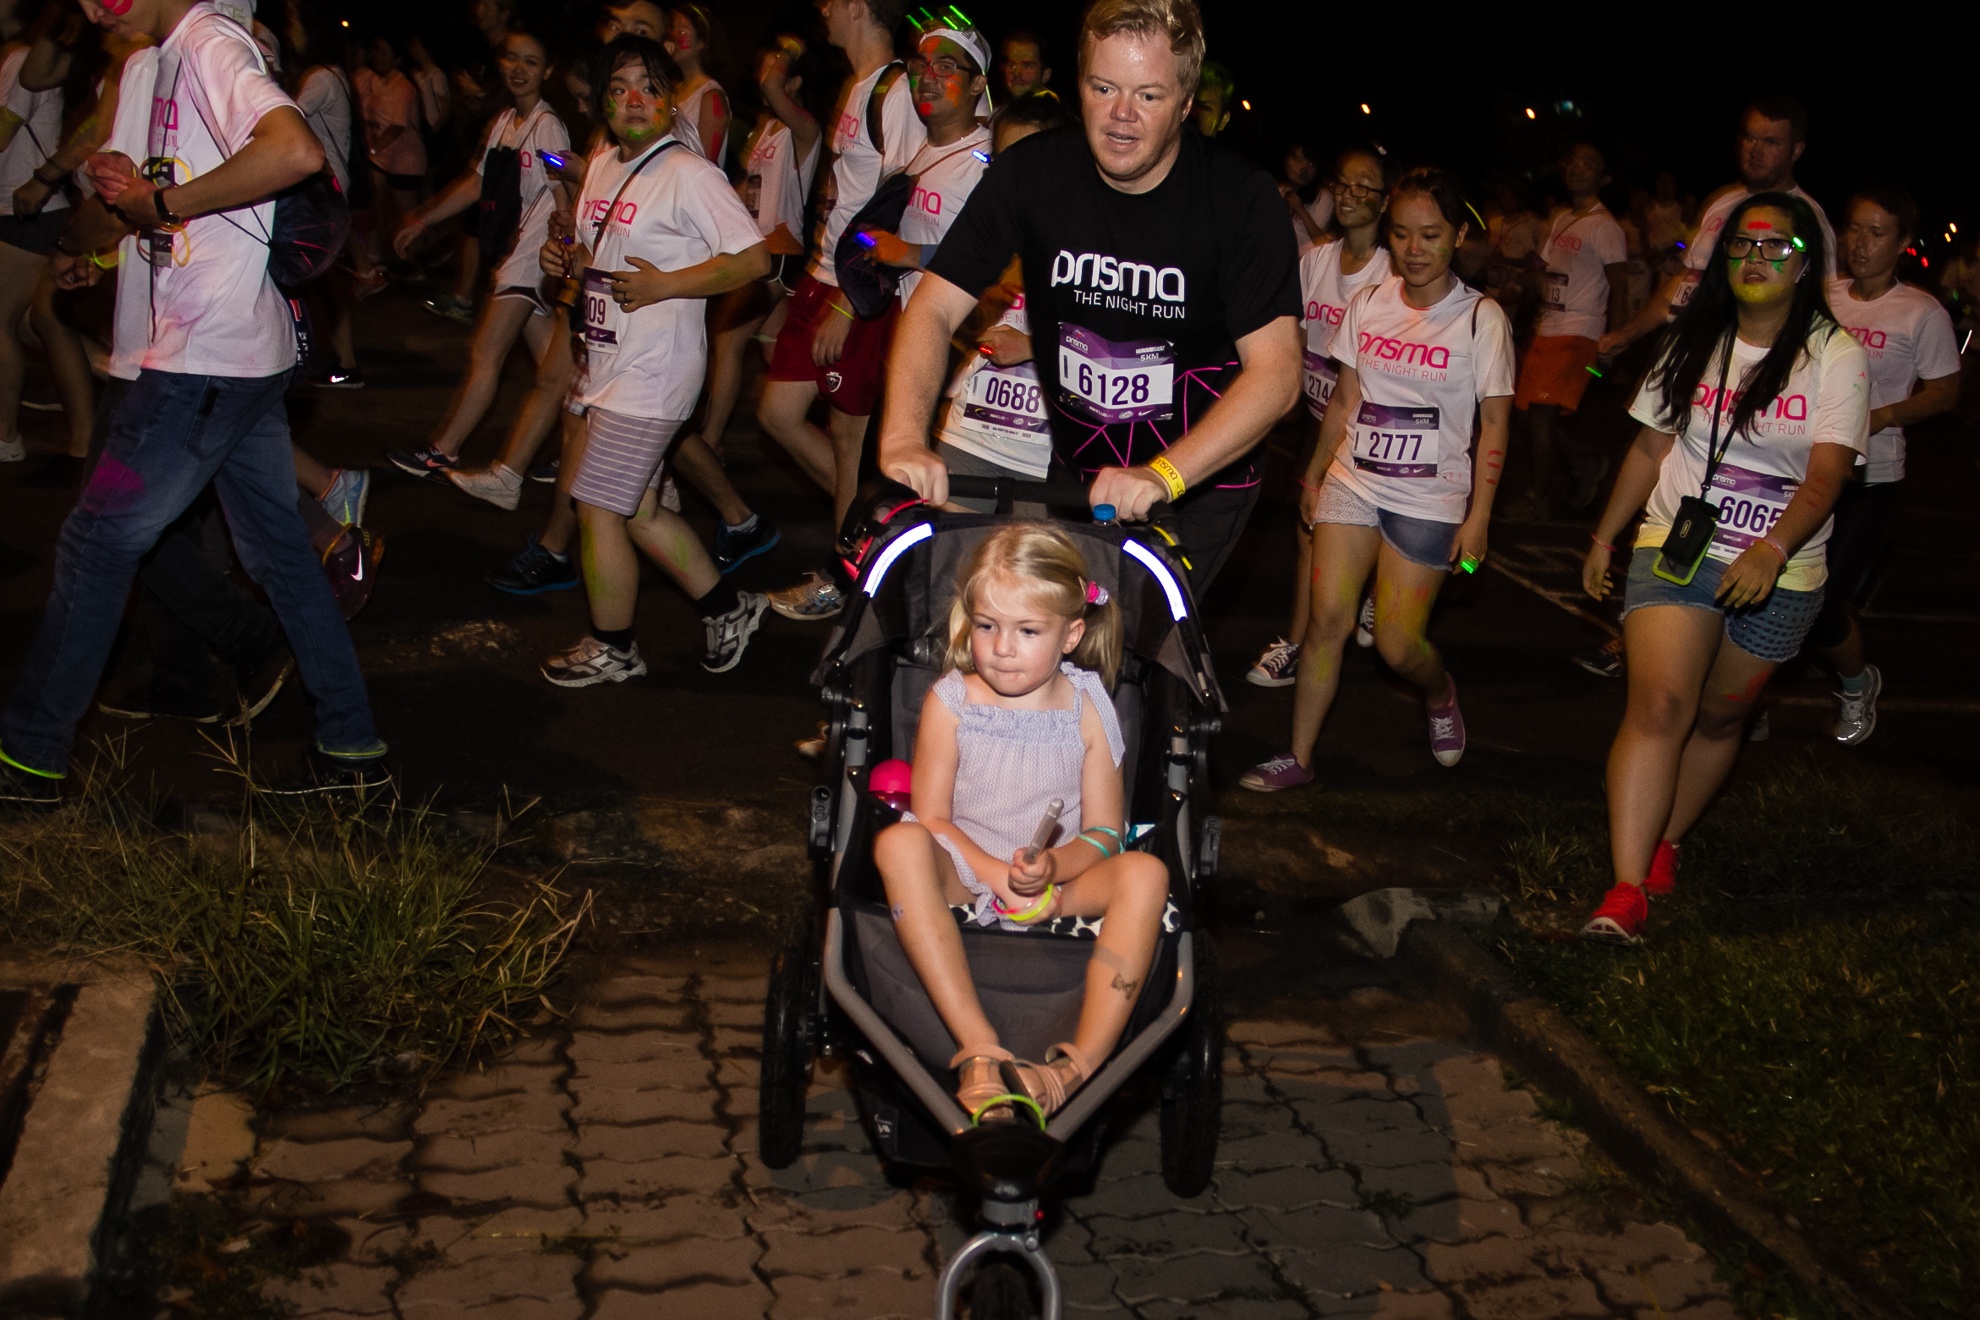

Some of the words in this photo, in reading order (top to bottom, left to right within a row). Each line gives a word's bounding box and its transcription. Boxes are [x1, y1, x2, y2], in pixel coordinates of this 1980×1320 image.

[1051, 250, 1185, 302] prisma
[1074, 290, 1102, 305] THE
[1106, 296, 1147, 315] NIGHT
[1153, 305, 1185, 319] RUN
[1307, 301, 1343, 325] pris
[1140, 353, 1160, 362] 5KM
[1358, 332, 1449, 369] prisma
[1079, 363, 1149, 405] 6128
[1361, 358, 1380, 370] THE
[1383, 363, 1418, 377] NIGHT
[1421, 370, 1447, 382] RUN
[985, 377, 1042, 413] 0688
[1309, 375, 1329, 402] 274
[1778, 424, 1806, 435] RUN
[1369, 431, 1423, 461] 2777
[1716, 496, 1784, 534] 6065
